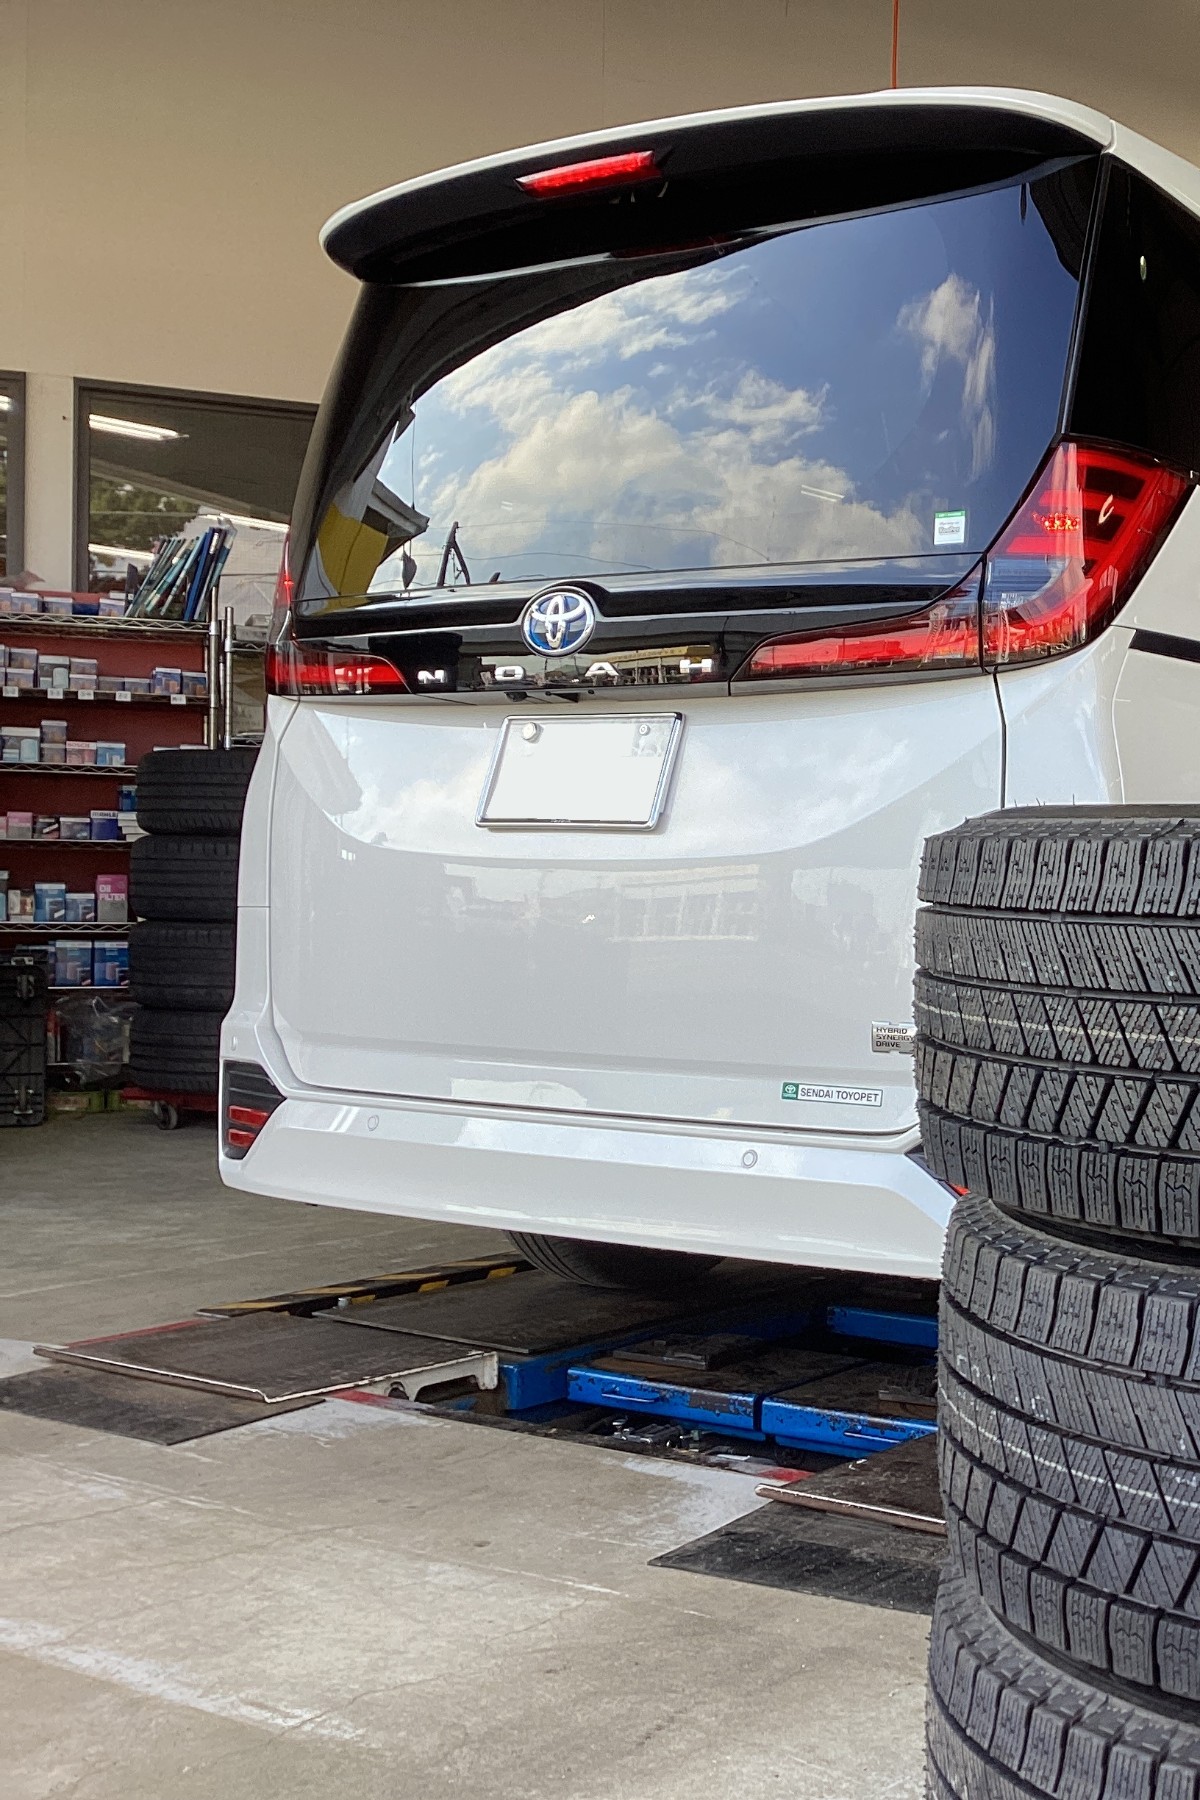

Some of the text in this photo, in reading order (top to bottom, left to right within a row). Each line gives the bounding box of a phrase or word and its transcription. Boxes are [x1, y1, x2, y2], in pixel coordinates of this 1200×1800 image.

[417, 658, 713, 684] NOAH
[876, 1027, 908, 1035] HYBRID
[875, 1040, 901, 1048] DRIVE
[800, 1087, 833, 1099] SENDAI
[836, 1090, 880, 1102] TOYOPET
